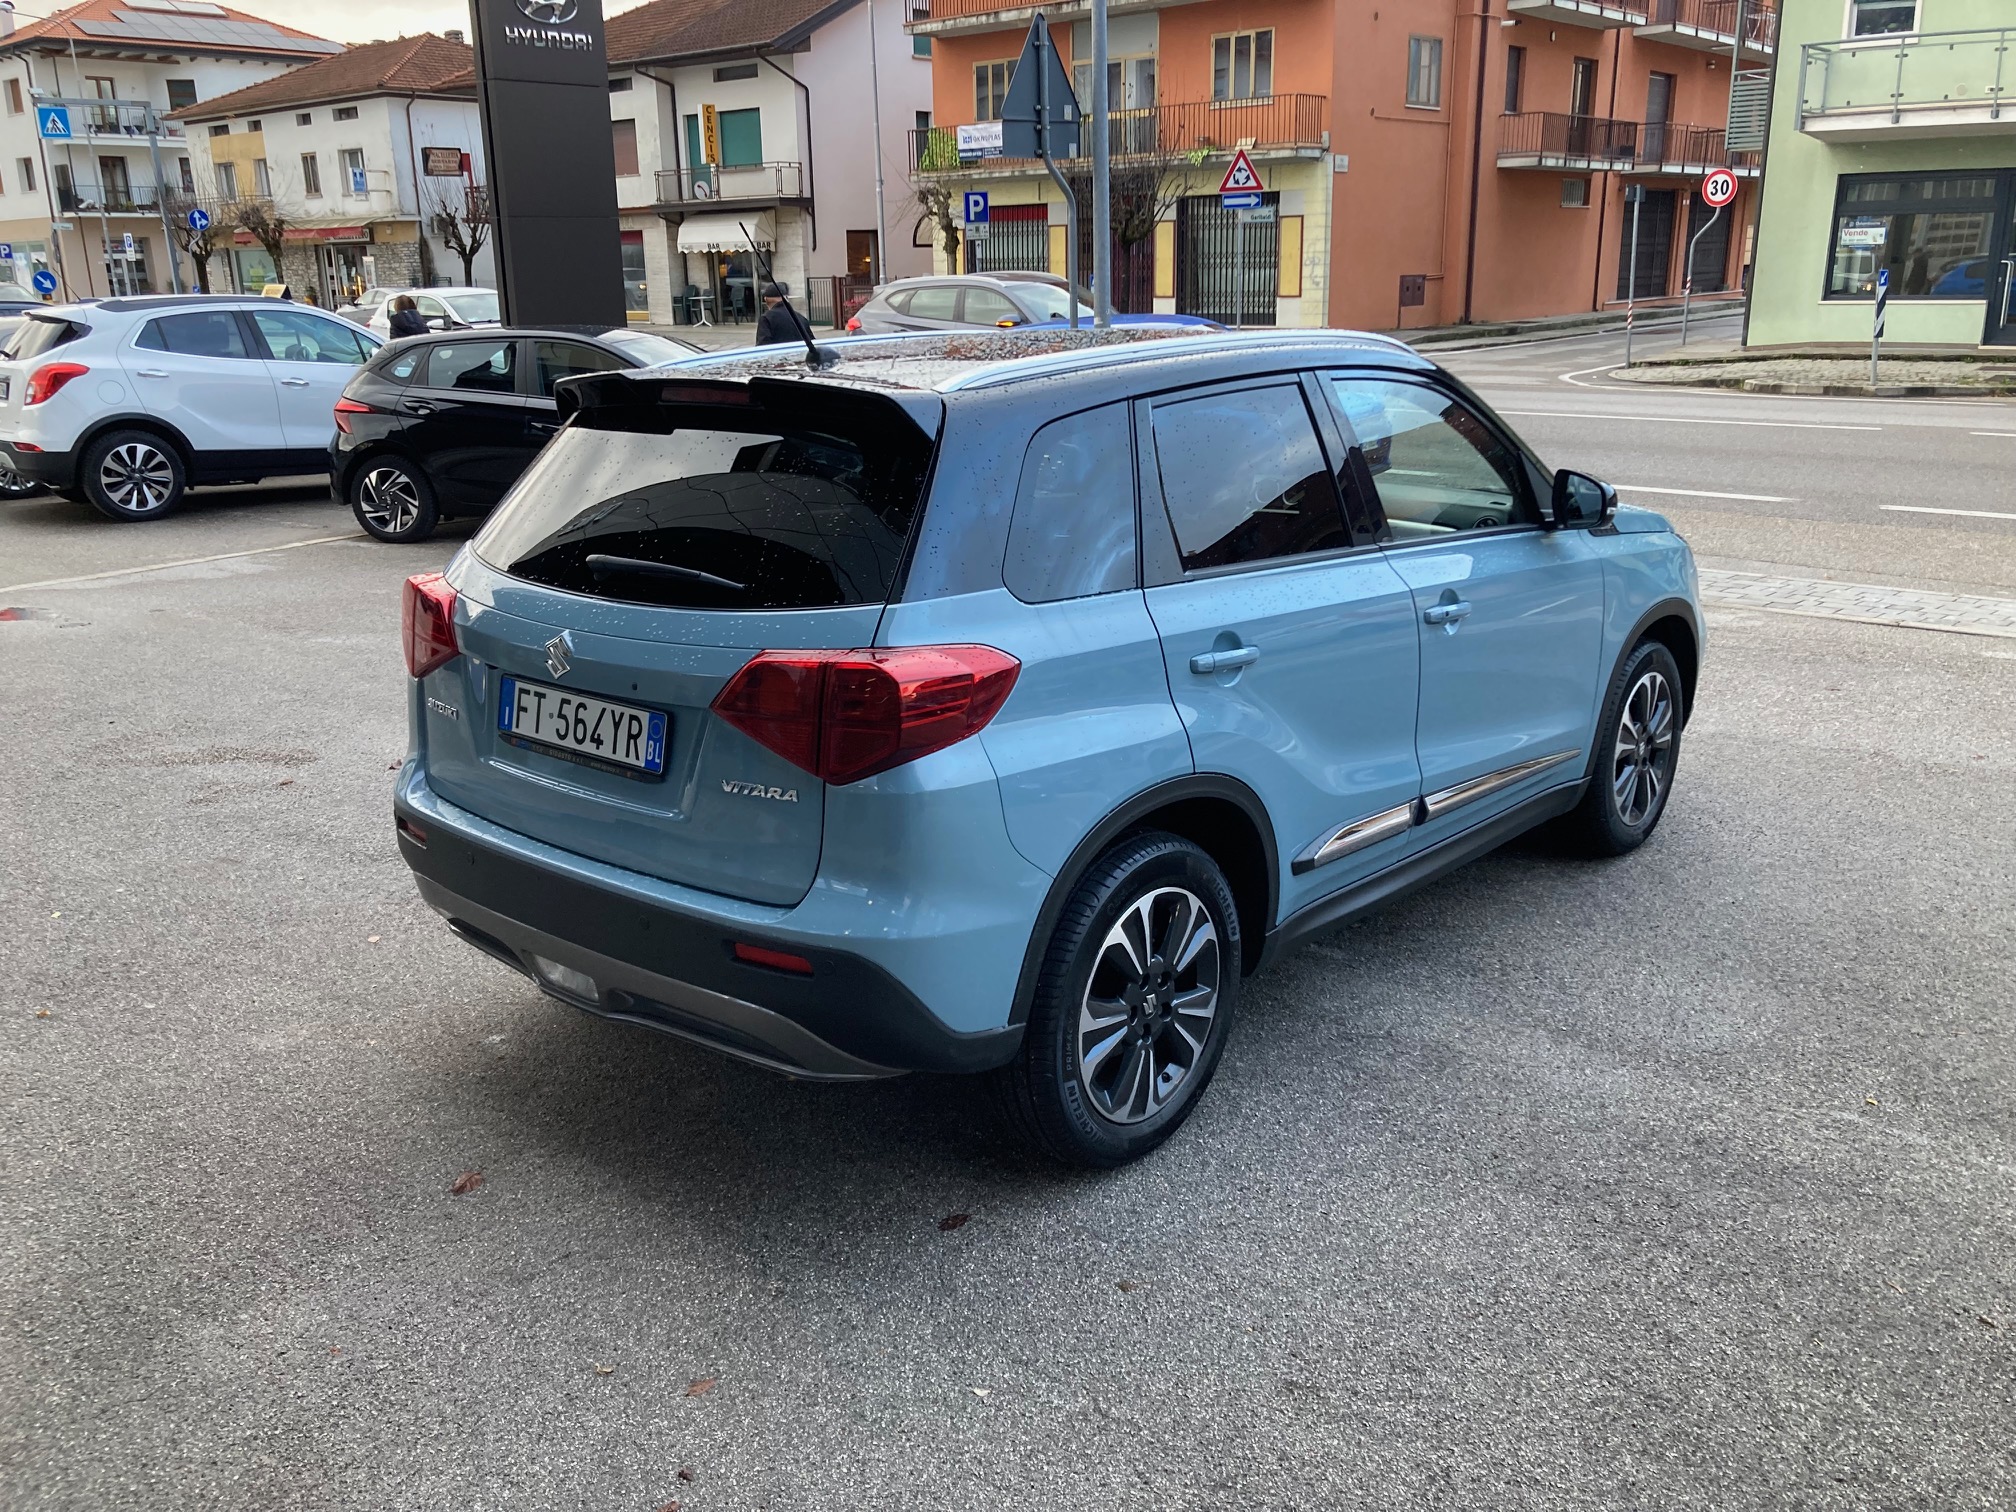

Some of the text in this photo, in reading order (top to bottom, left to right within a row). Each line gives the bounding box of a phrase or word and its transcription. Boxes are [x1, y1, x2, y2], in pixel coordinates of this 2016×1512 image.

[504, 25, 592, 51] HYUNDAI
[1710, 179, 1729, 196] 30
[969, 194, 984, 221] P
[1250, 213, 1271, 221] Garibaldi
[0, 246, 9, 258] P
[756, 242, 771, 250] BAR
[515, 687, 643, 762] FT 564YR
[646, 739, 661, 764] BL
[721, 779, 799, 803] VITARA
